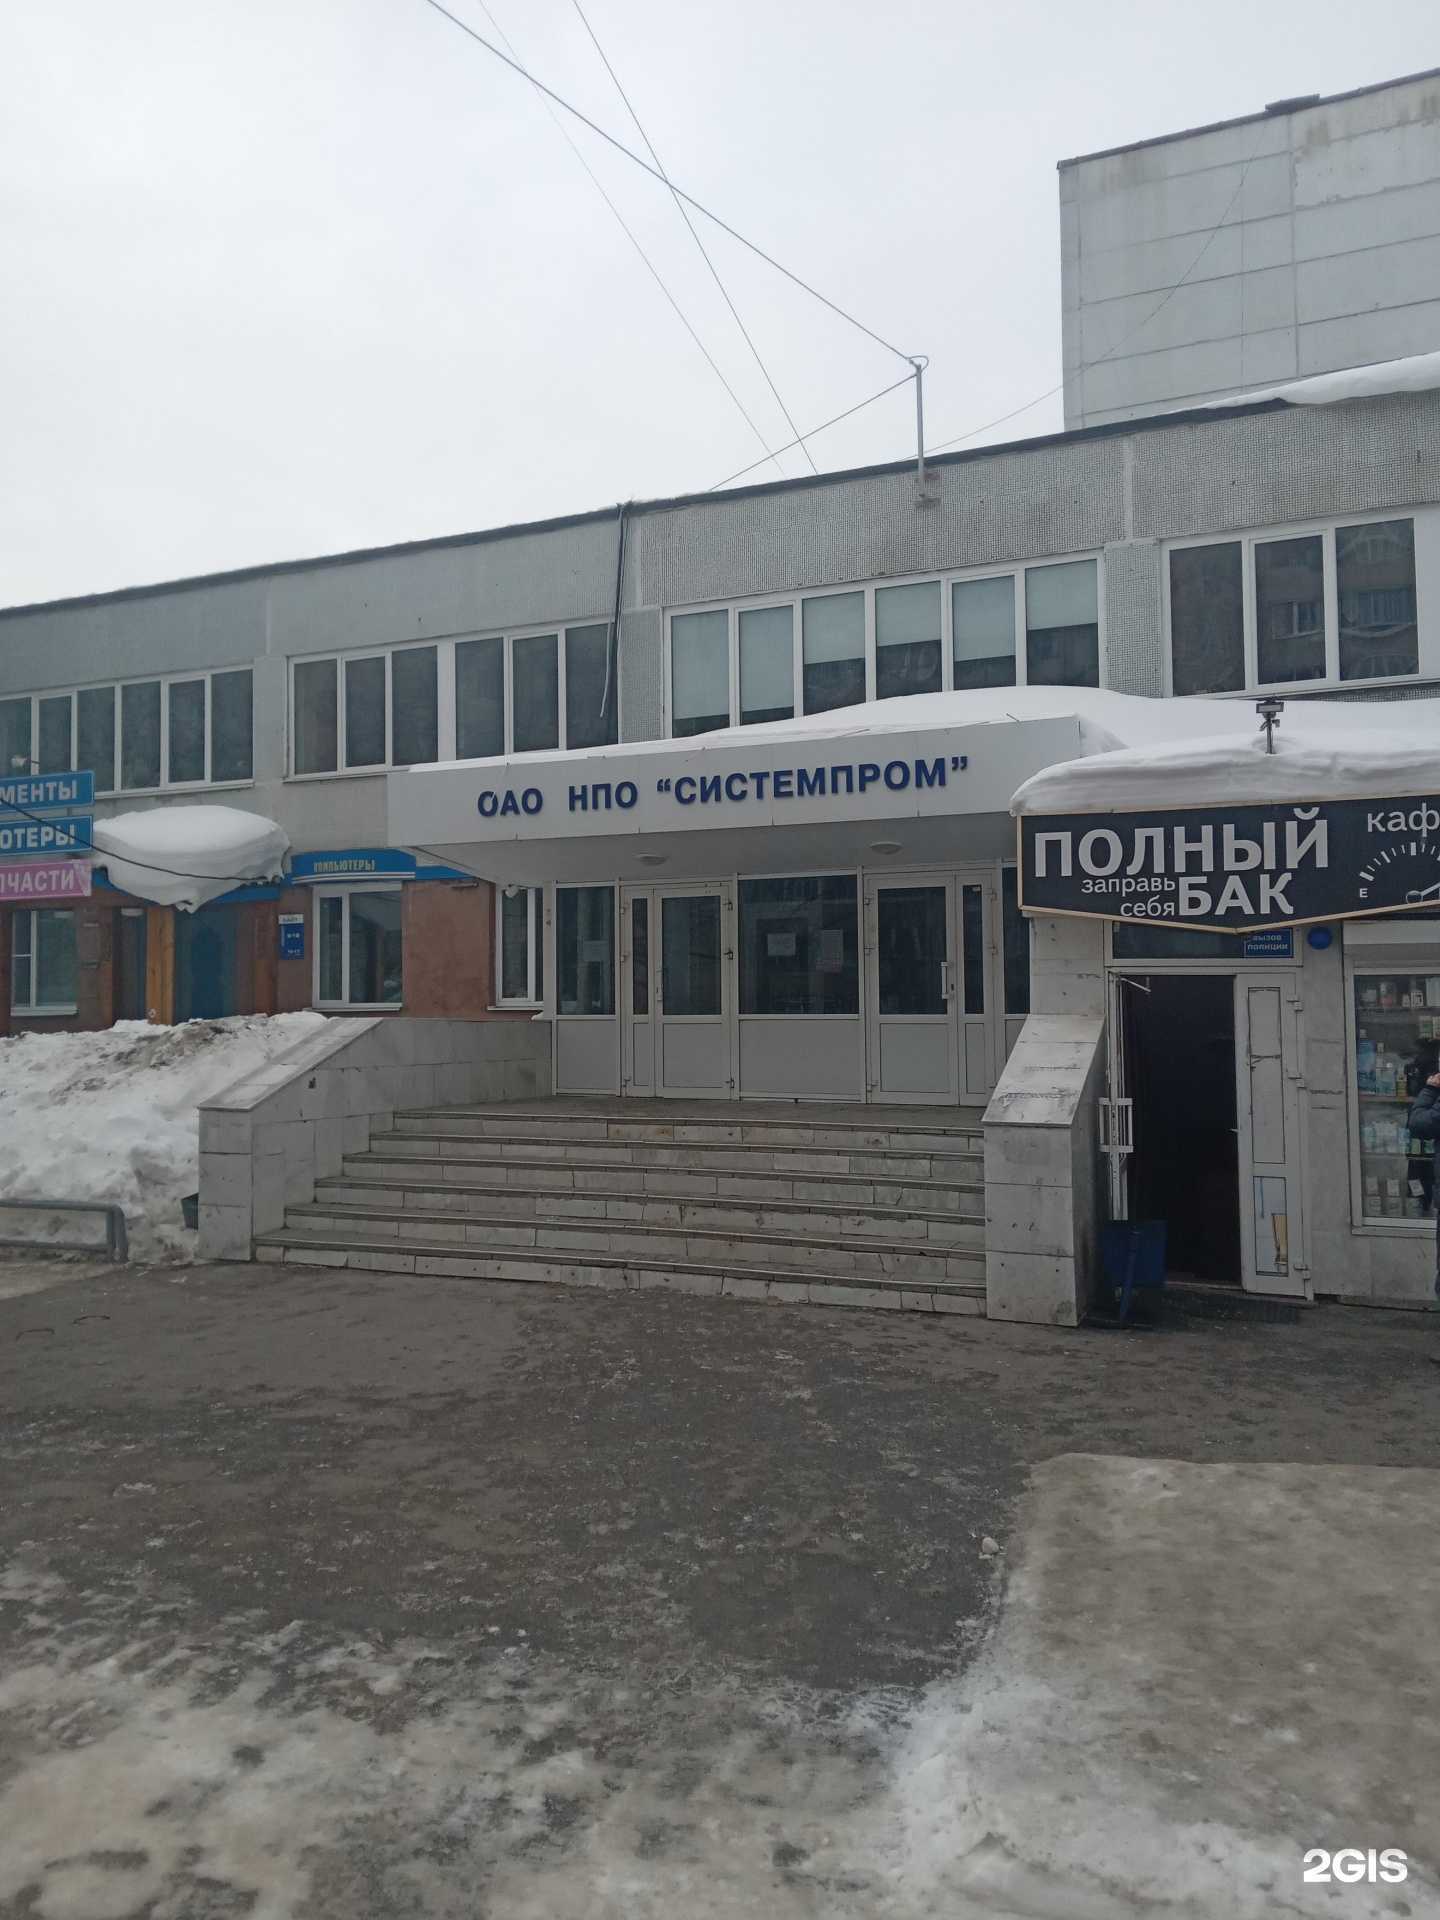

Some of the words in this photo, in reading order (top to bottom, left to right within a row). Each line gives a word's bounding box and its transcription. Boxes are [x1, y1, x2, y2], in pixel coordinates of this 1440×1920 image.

[477, 788, 543, 817] ОАО
[568, 781, 639, 812] НПО
[1367, 802, 1440, 838] каф
[1034, 807, 1328, 878] ПОЛНЫЙ
[1081, 877, 1176, 897] заправь
[1178, 872, 1294, 916] БАК
[1120, 895, 1175, 917] себя
